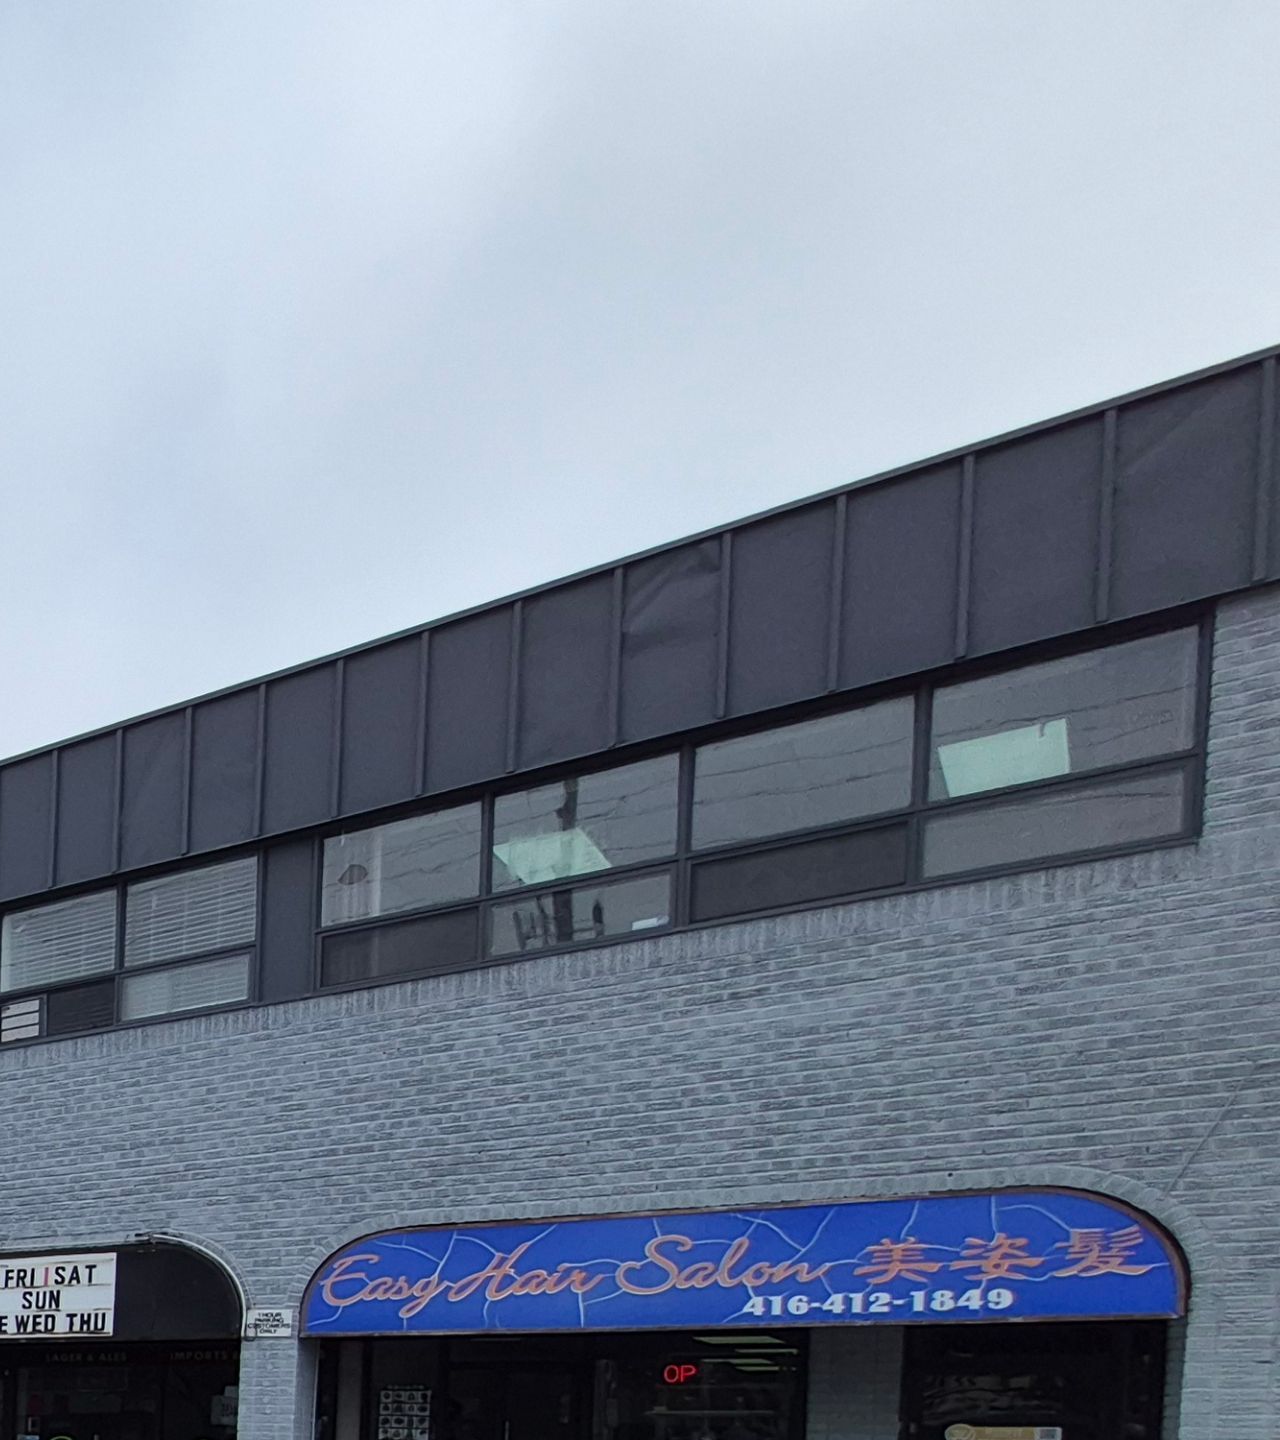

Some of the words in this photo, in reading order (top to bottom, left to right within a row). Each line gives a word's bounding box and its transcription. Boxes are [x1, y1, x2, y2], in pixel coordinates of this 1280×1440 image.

[4, 1268, 36, 1288] FRI
[54, 1264, 98, 1286] SAT
[320, 1254, 447, 1319] Easy
[447, 1241, 605, 1302] Hair
[615, 1234, 828, 1295] Salon
[22, 1290, 61, 1311] SUN
[742, 1287, 1014, 1317] 416-412-1849
[15, 1314, 56, 1334] WED
[66, 1312, 107, 1333] THU
